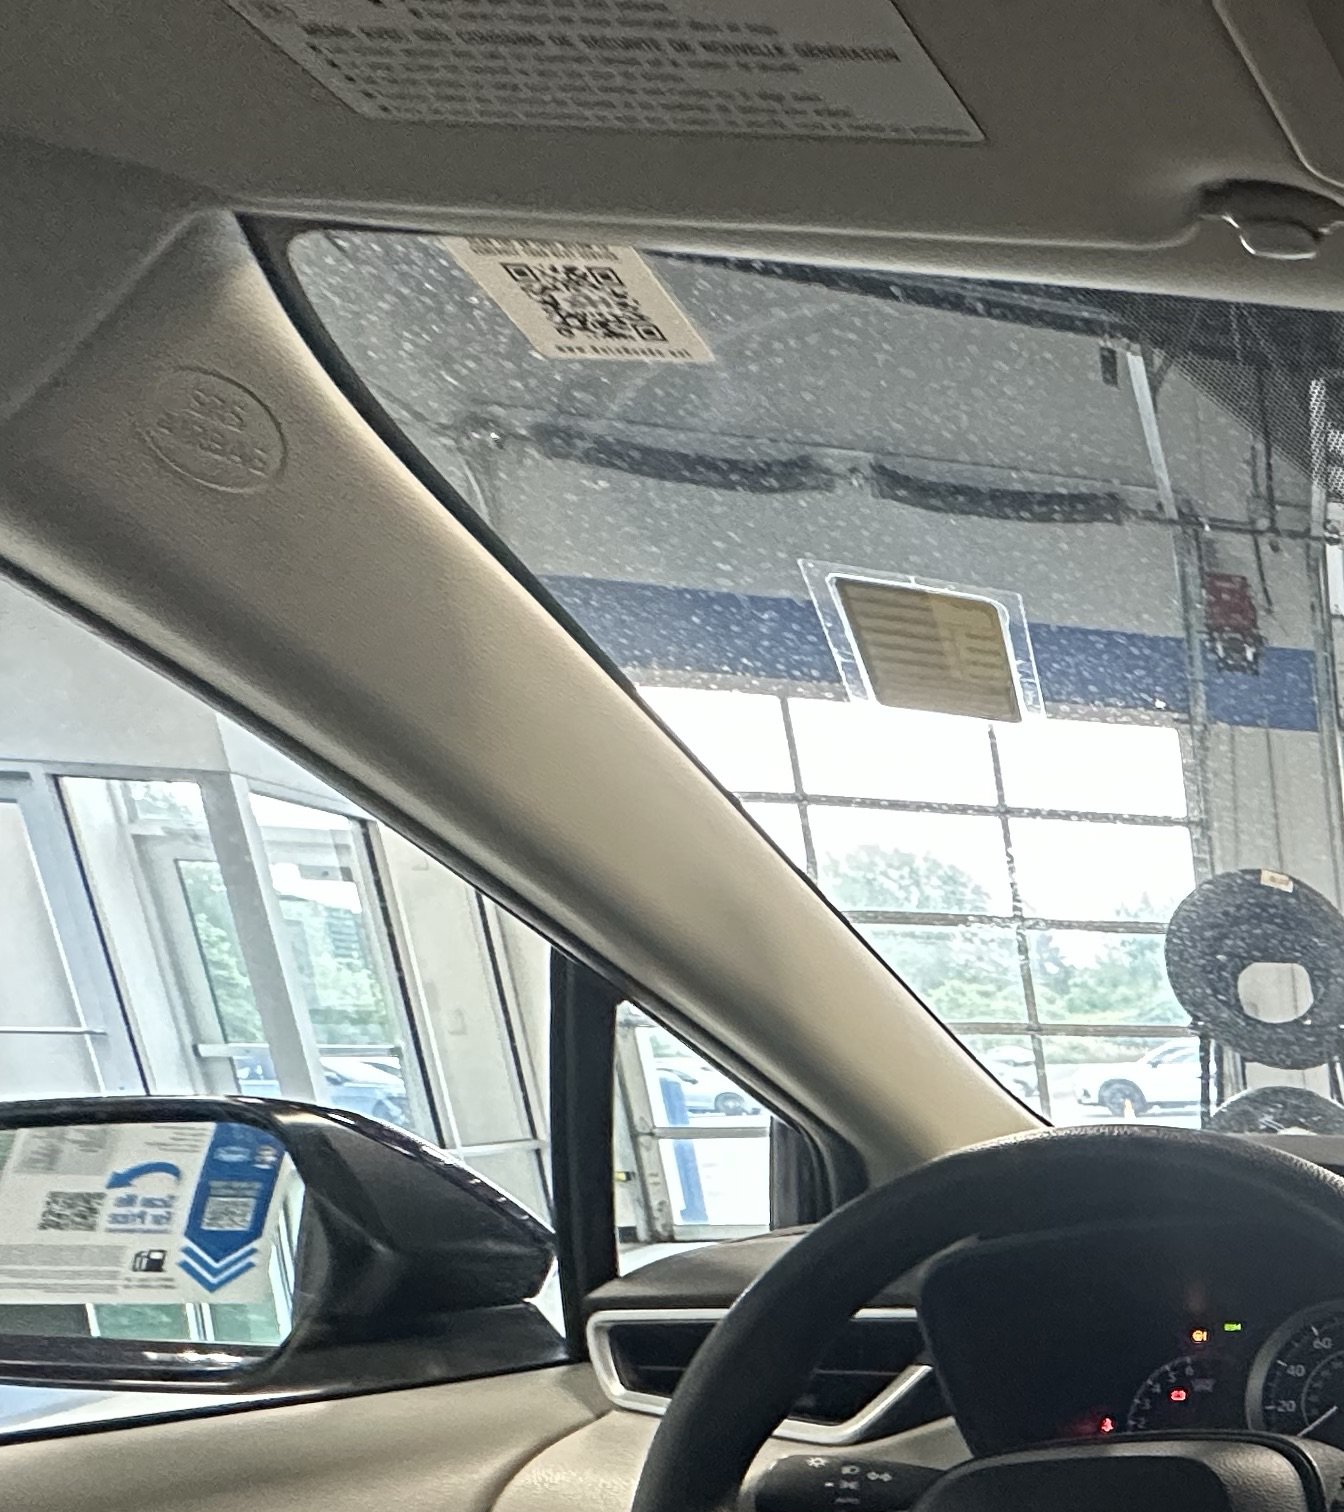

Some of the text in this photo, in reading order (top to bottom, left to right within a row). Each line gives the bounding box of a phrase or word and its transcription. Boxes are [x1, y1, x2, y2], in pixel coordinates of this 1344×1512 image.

[1313, 1337, 1333, 1349] 60
[1286, 1365, 1306, 1377] 40
[1277, 1400, 1296, 1412] 20
